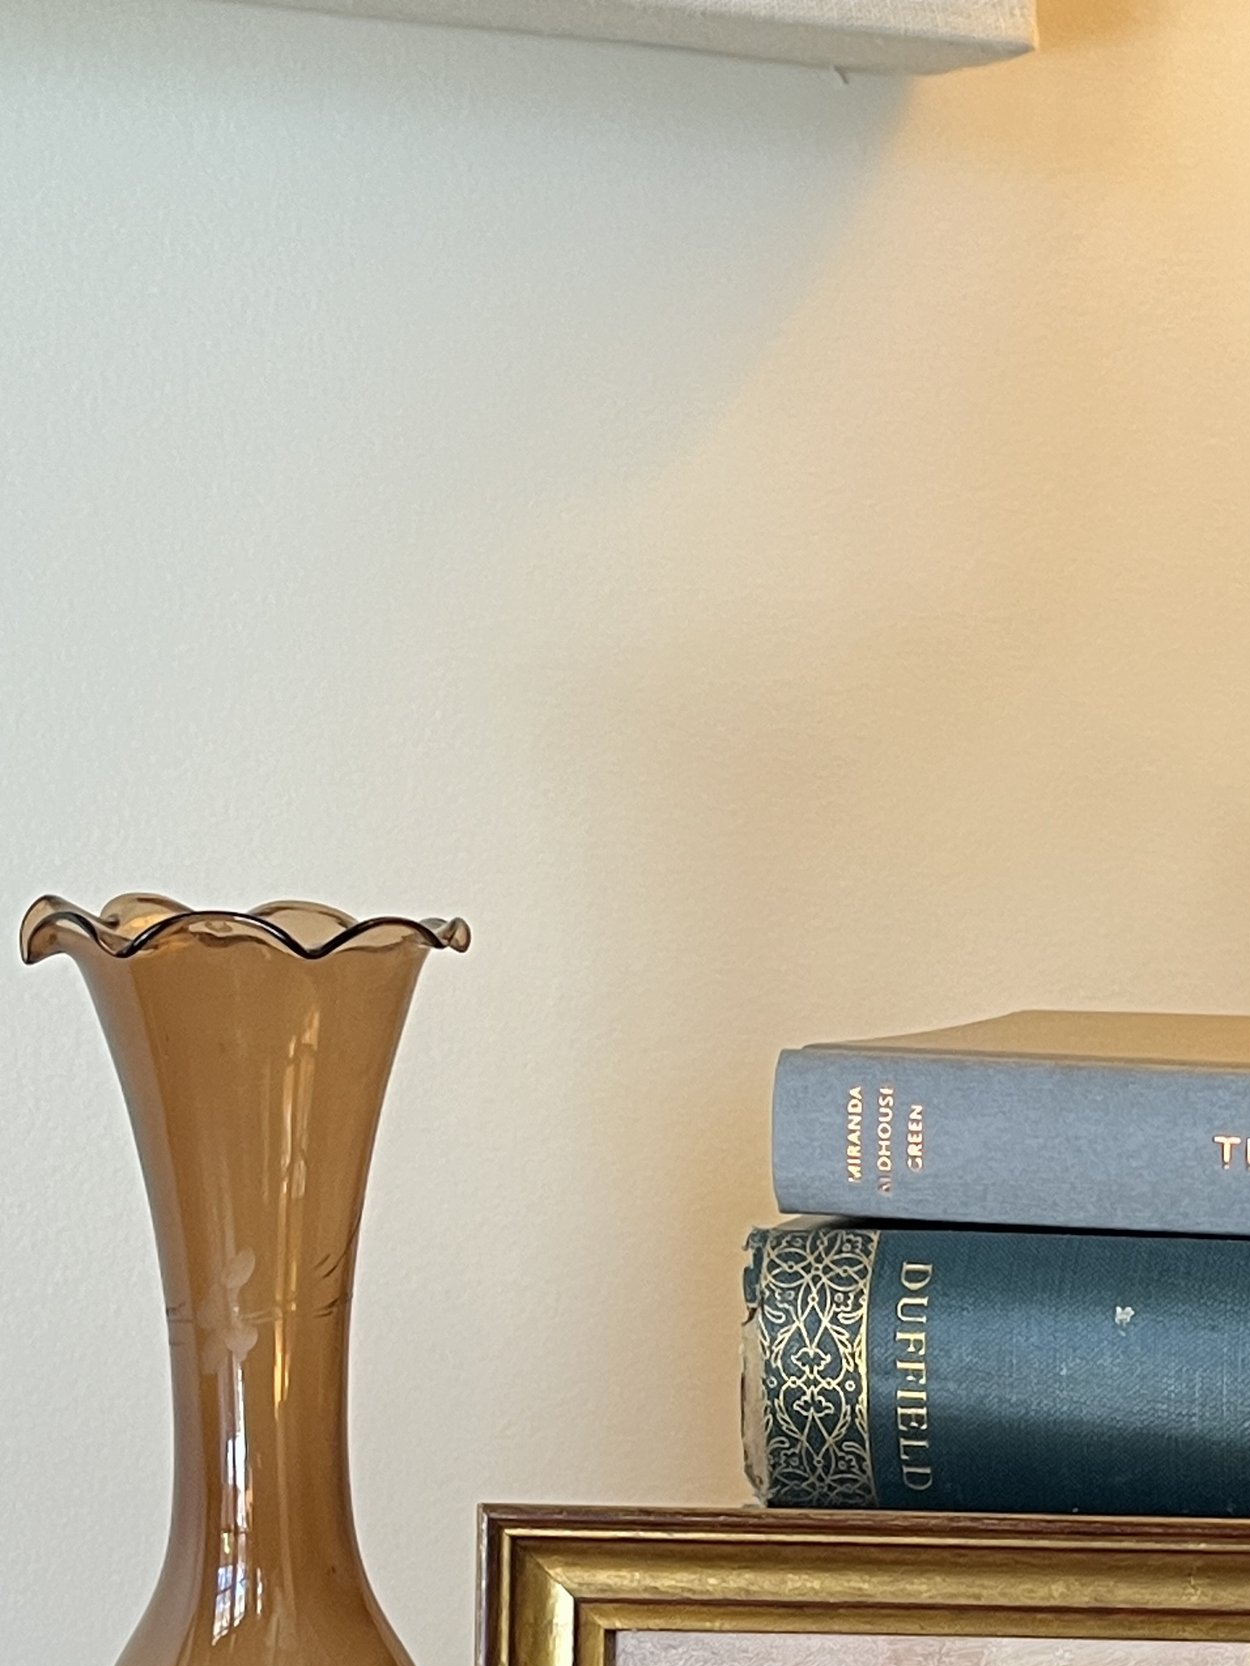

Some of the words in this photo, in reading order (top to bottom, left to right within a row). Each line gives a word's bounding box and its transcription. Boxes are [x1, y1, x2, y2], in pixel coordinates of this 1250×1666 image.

[847, 1086, 863, 1184] MIRANDA
[906, 1104, 924, 1173] GREEN
[895, 1260, 934, 1493] DUFFIELD
